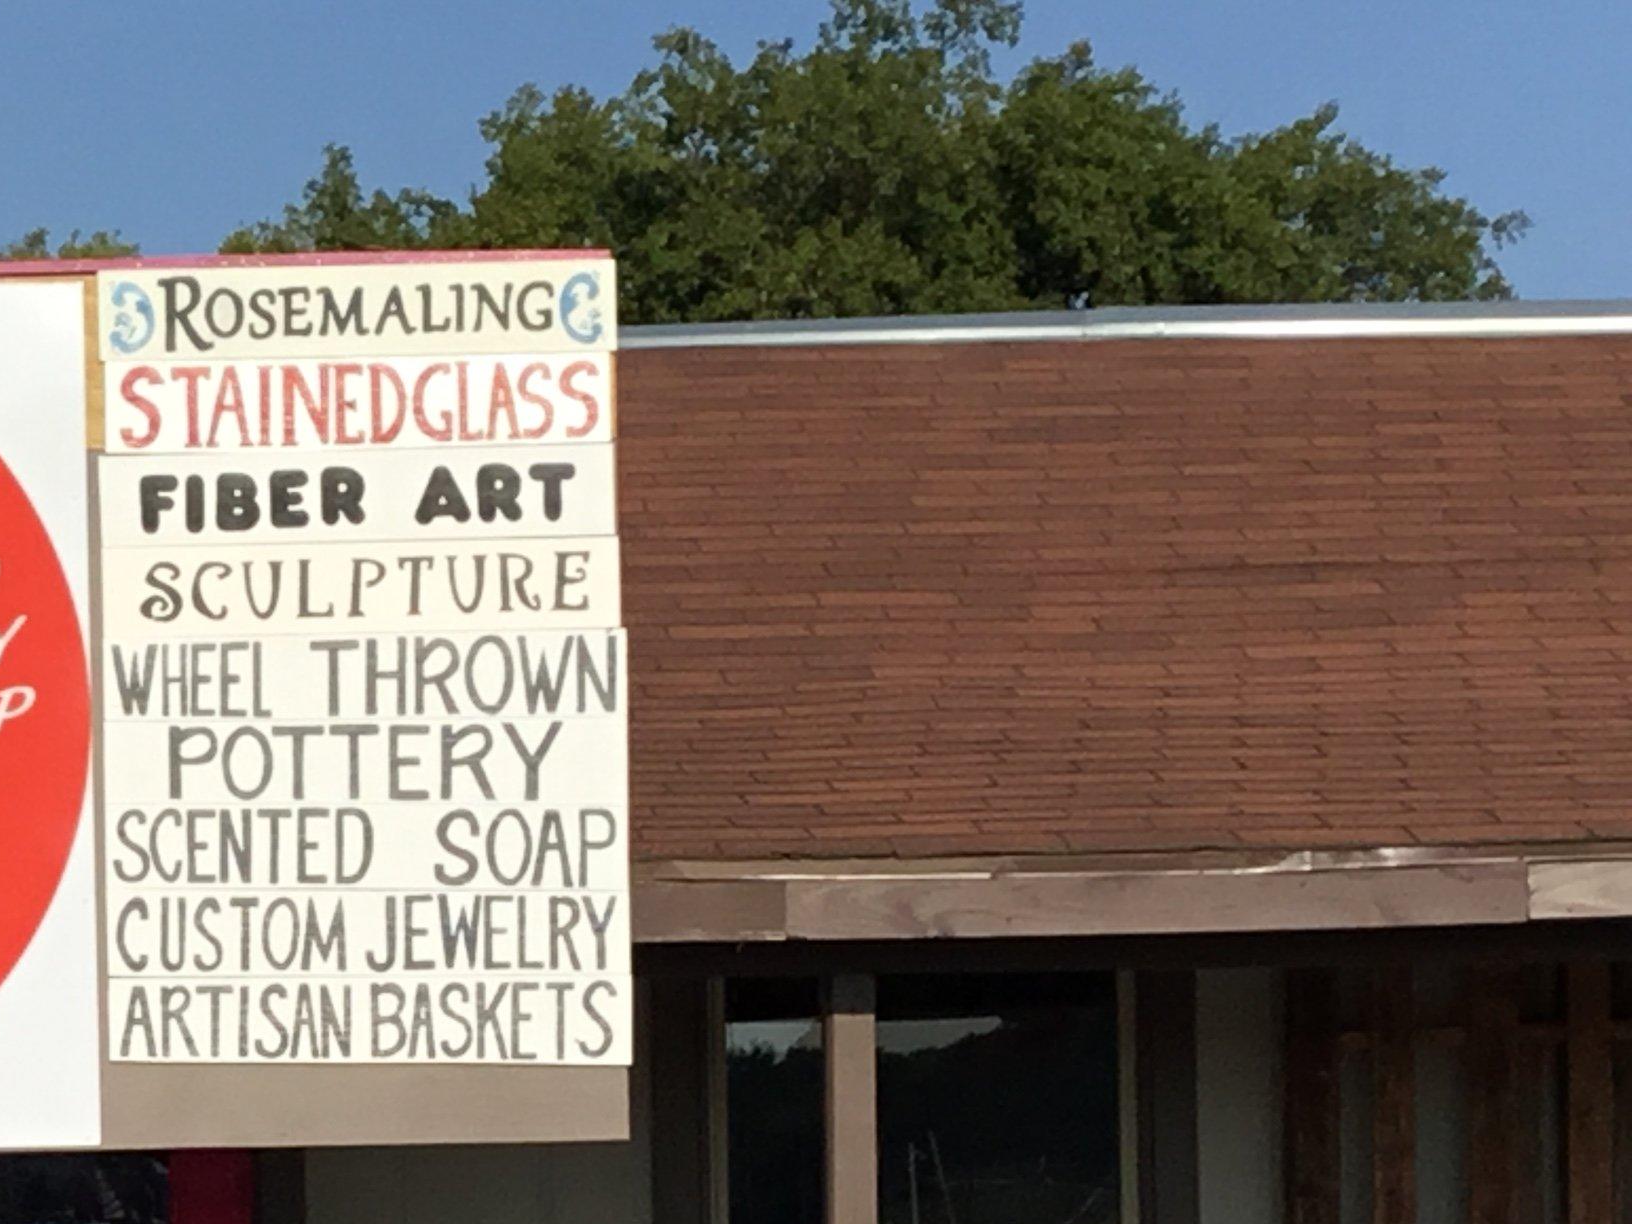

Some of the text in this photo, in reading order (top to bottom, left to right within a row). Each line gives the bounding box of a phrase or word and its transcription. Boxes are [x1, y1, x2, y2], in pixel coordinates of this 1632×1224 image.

[158, 276, 554, 352] ROSEMALING
[139, 463, 576, 534] FIBER ART
[139, 552, 590, 622] SCULPTURE
[111, 635, 617, 718] WHEEL THROWN
[169, 722, 563, 801] POTTERY
[113, 808, 616, 888] SCENTED SOAP
[117, 894, 617, 972] CUSTOM JEWELRY
[119, 980, 618, 1060] ARTISAN BASKETS
